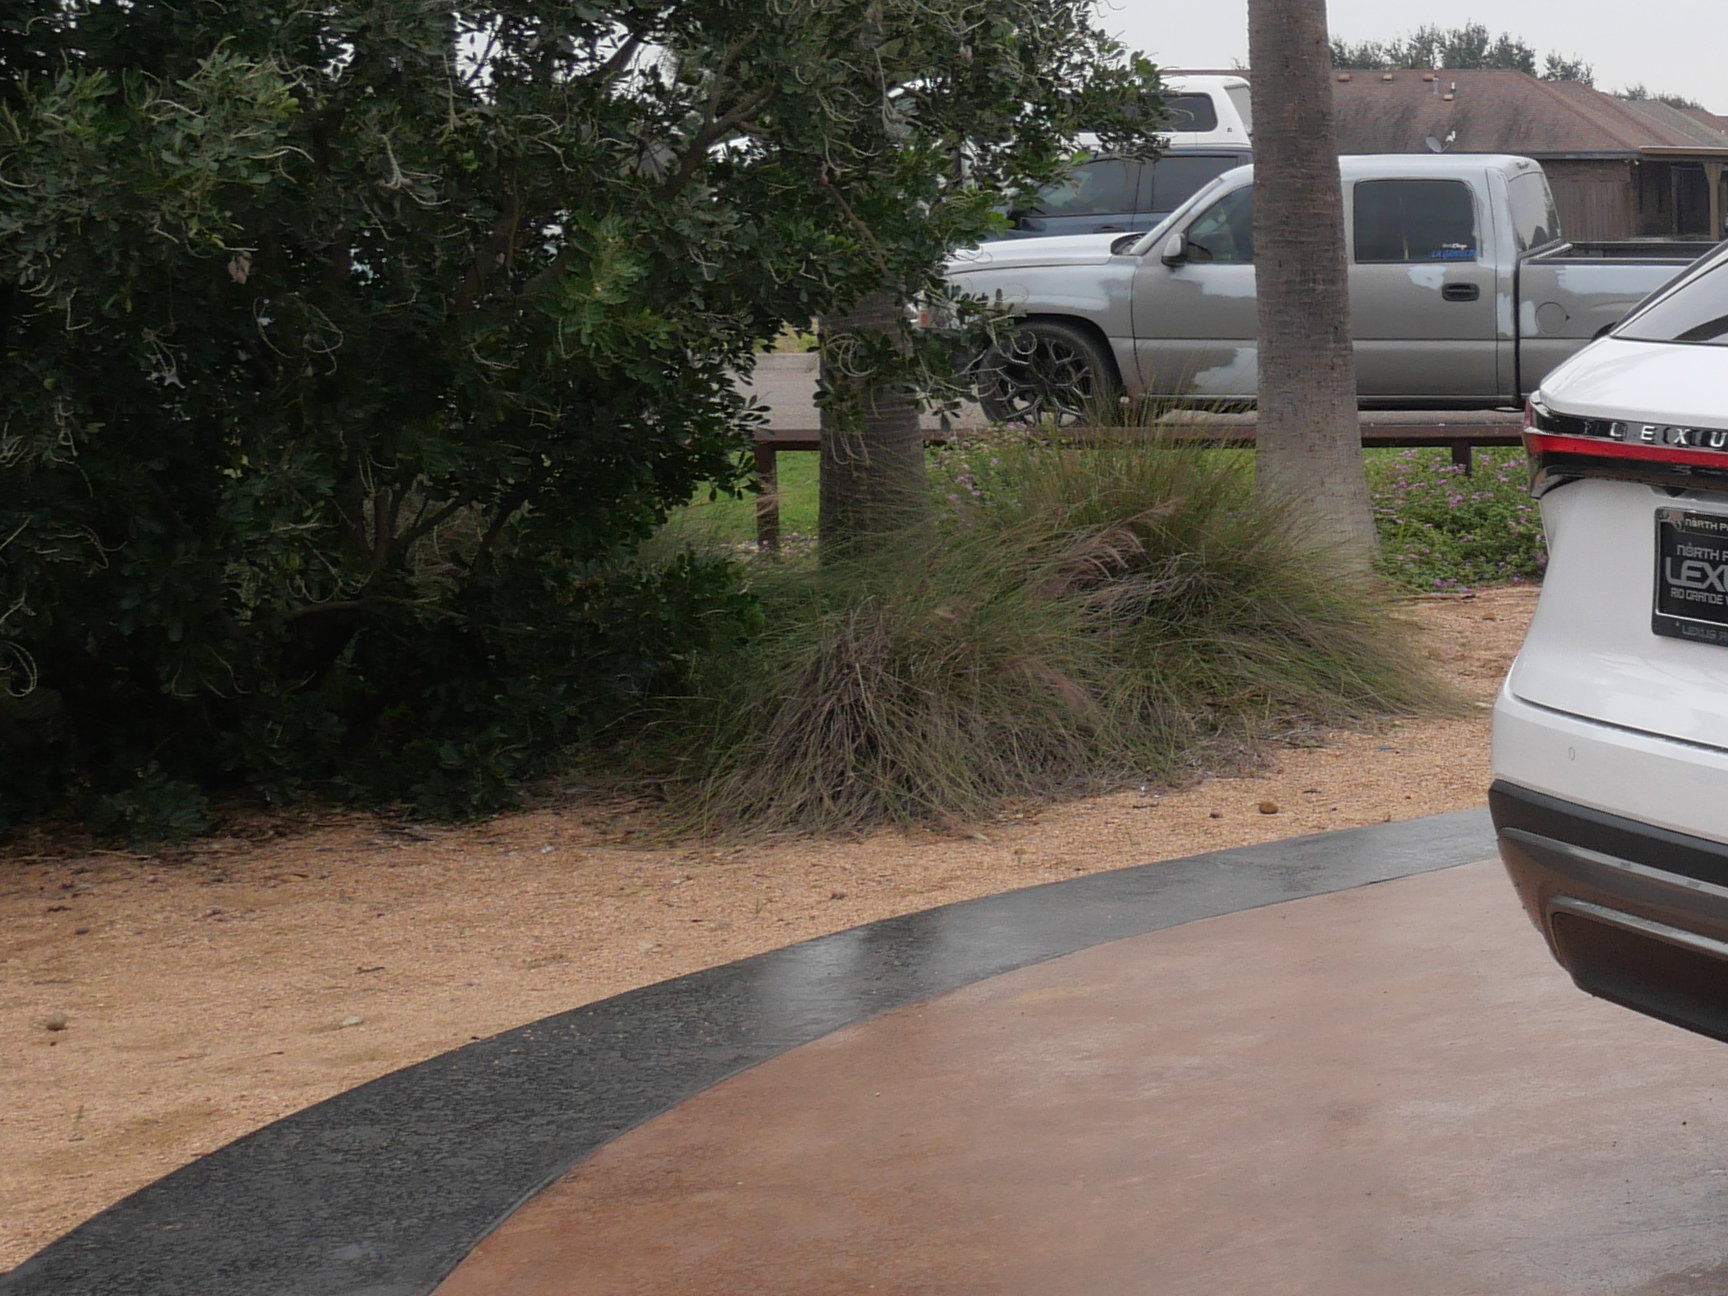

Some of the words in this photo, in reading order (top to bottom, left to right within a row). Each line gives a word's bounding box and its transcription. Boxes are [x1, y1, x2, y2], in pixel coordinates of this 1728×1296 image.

[1670, 587, 1685, 600] RIO
[1686, 589, 1724, 605] GRANDE
[1681, 624, 1717, 640] LEXUS
